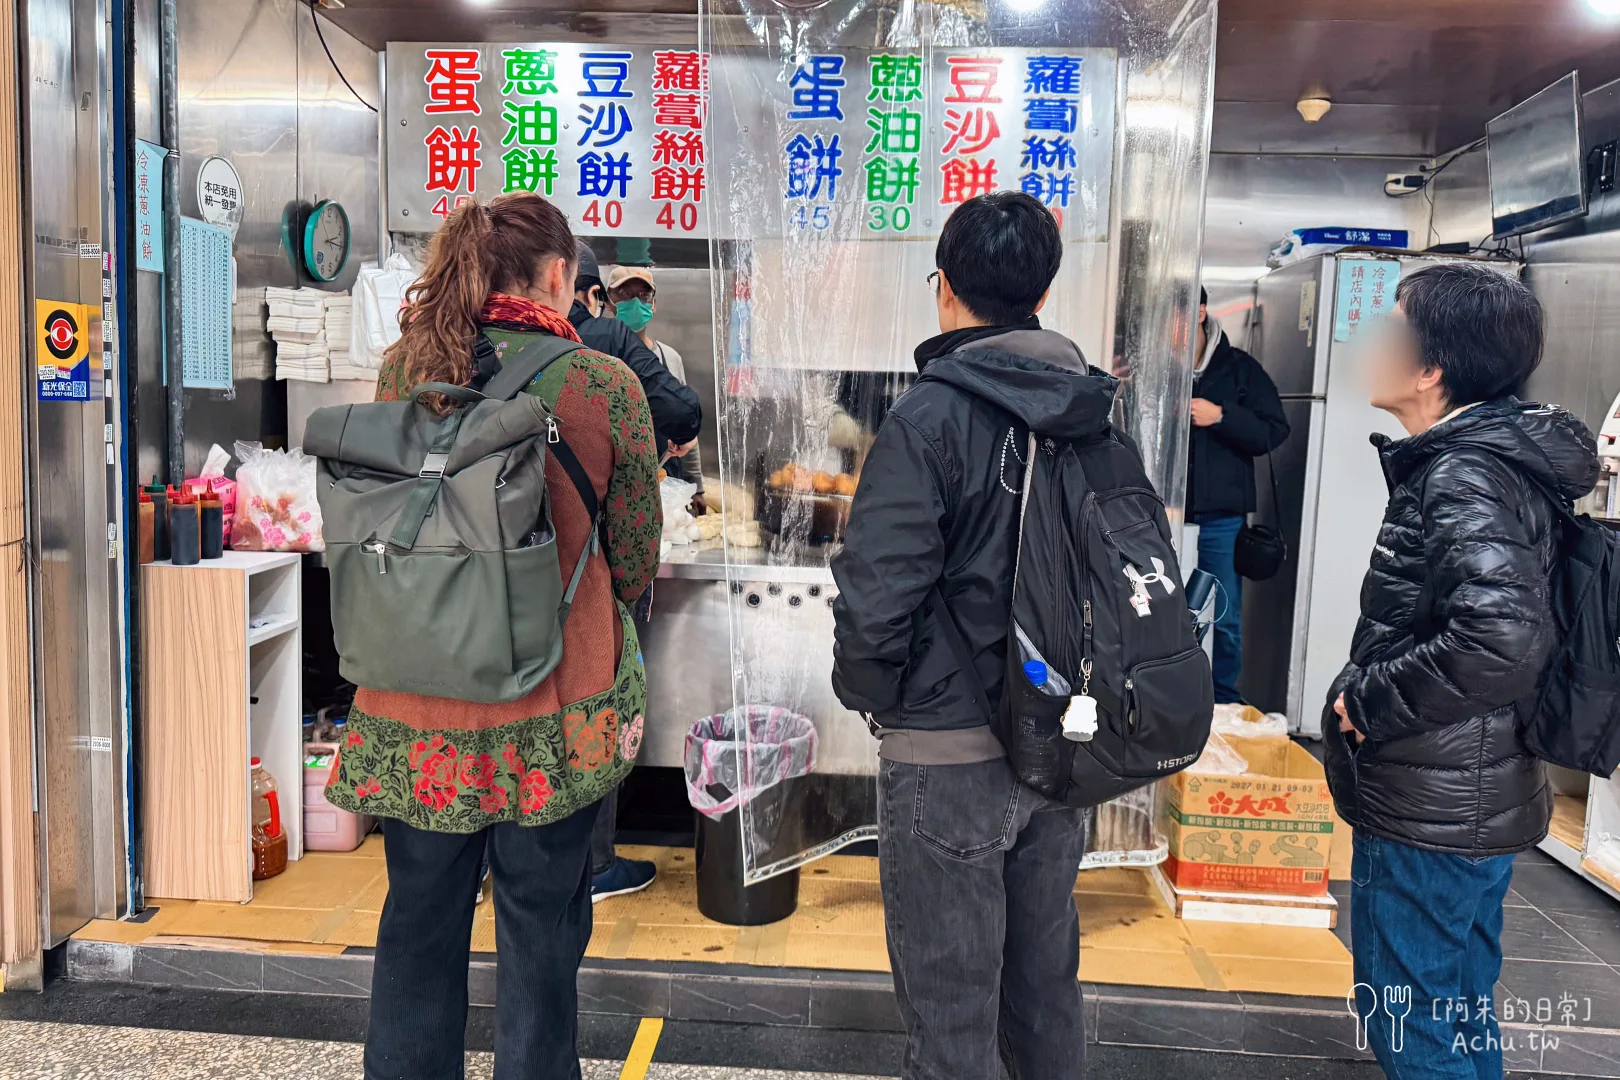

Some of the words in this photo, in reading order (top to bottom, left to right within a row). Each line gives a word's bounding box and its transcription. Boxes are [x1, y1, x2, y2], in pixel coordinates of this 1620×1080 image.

[204, 181, 237, 200] 本店免用
[425, 49, 482, 193] 蛋餅
[501, 49, 559, 195] 蔥油餅
[576, 51, 635, 199] 豆沙餅
[650, 51, 711, 202] 蘿蔔絲餅
[785, 55, 846, 201] 蛋餅
[864, 53, 925, 204] 蔥油餅
[939, 55, 1003, 205] 豆沙餅
[1020, 55, 1083, 208] 蘿蔔絲餅
[582, 200, 623, 228] 40
[656, 202, 698, 231] 40
[789, 205, 830, 230] 45
[868, 205, 911, 231] 30
